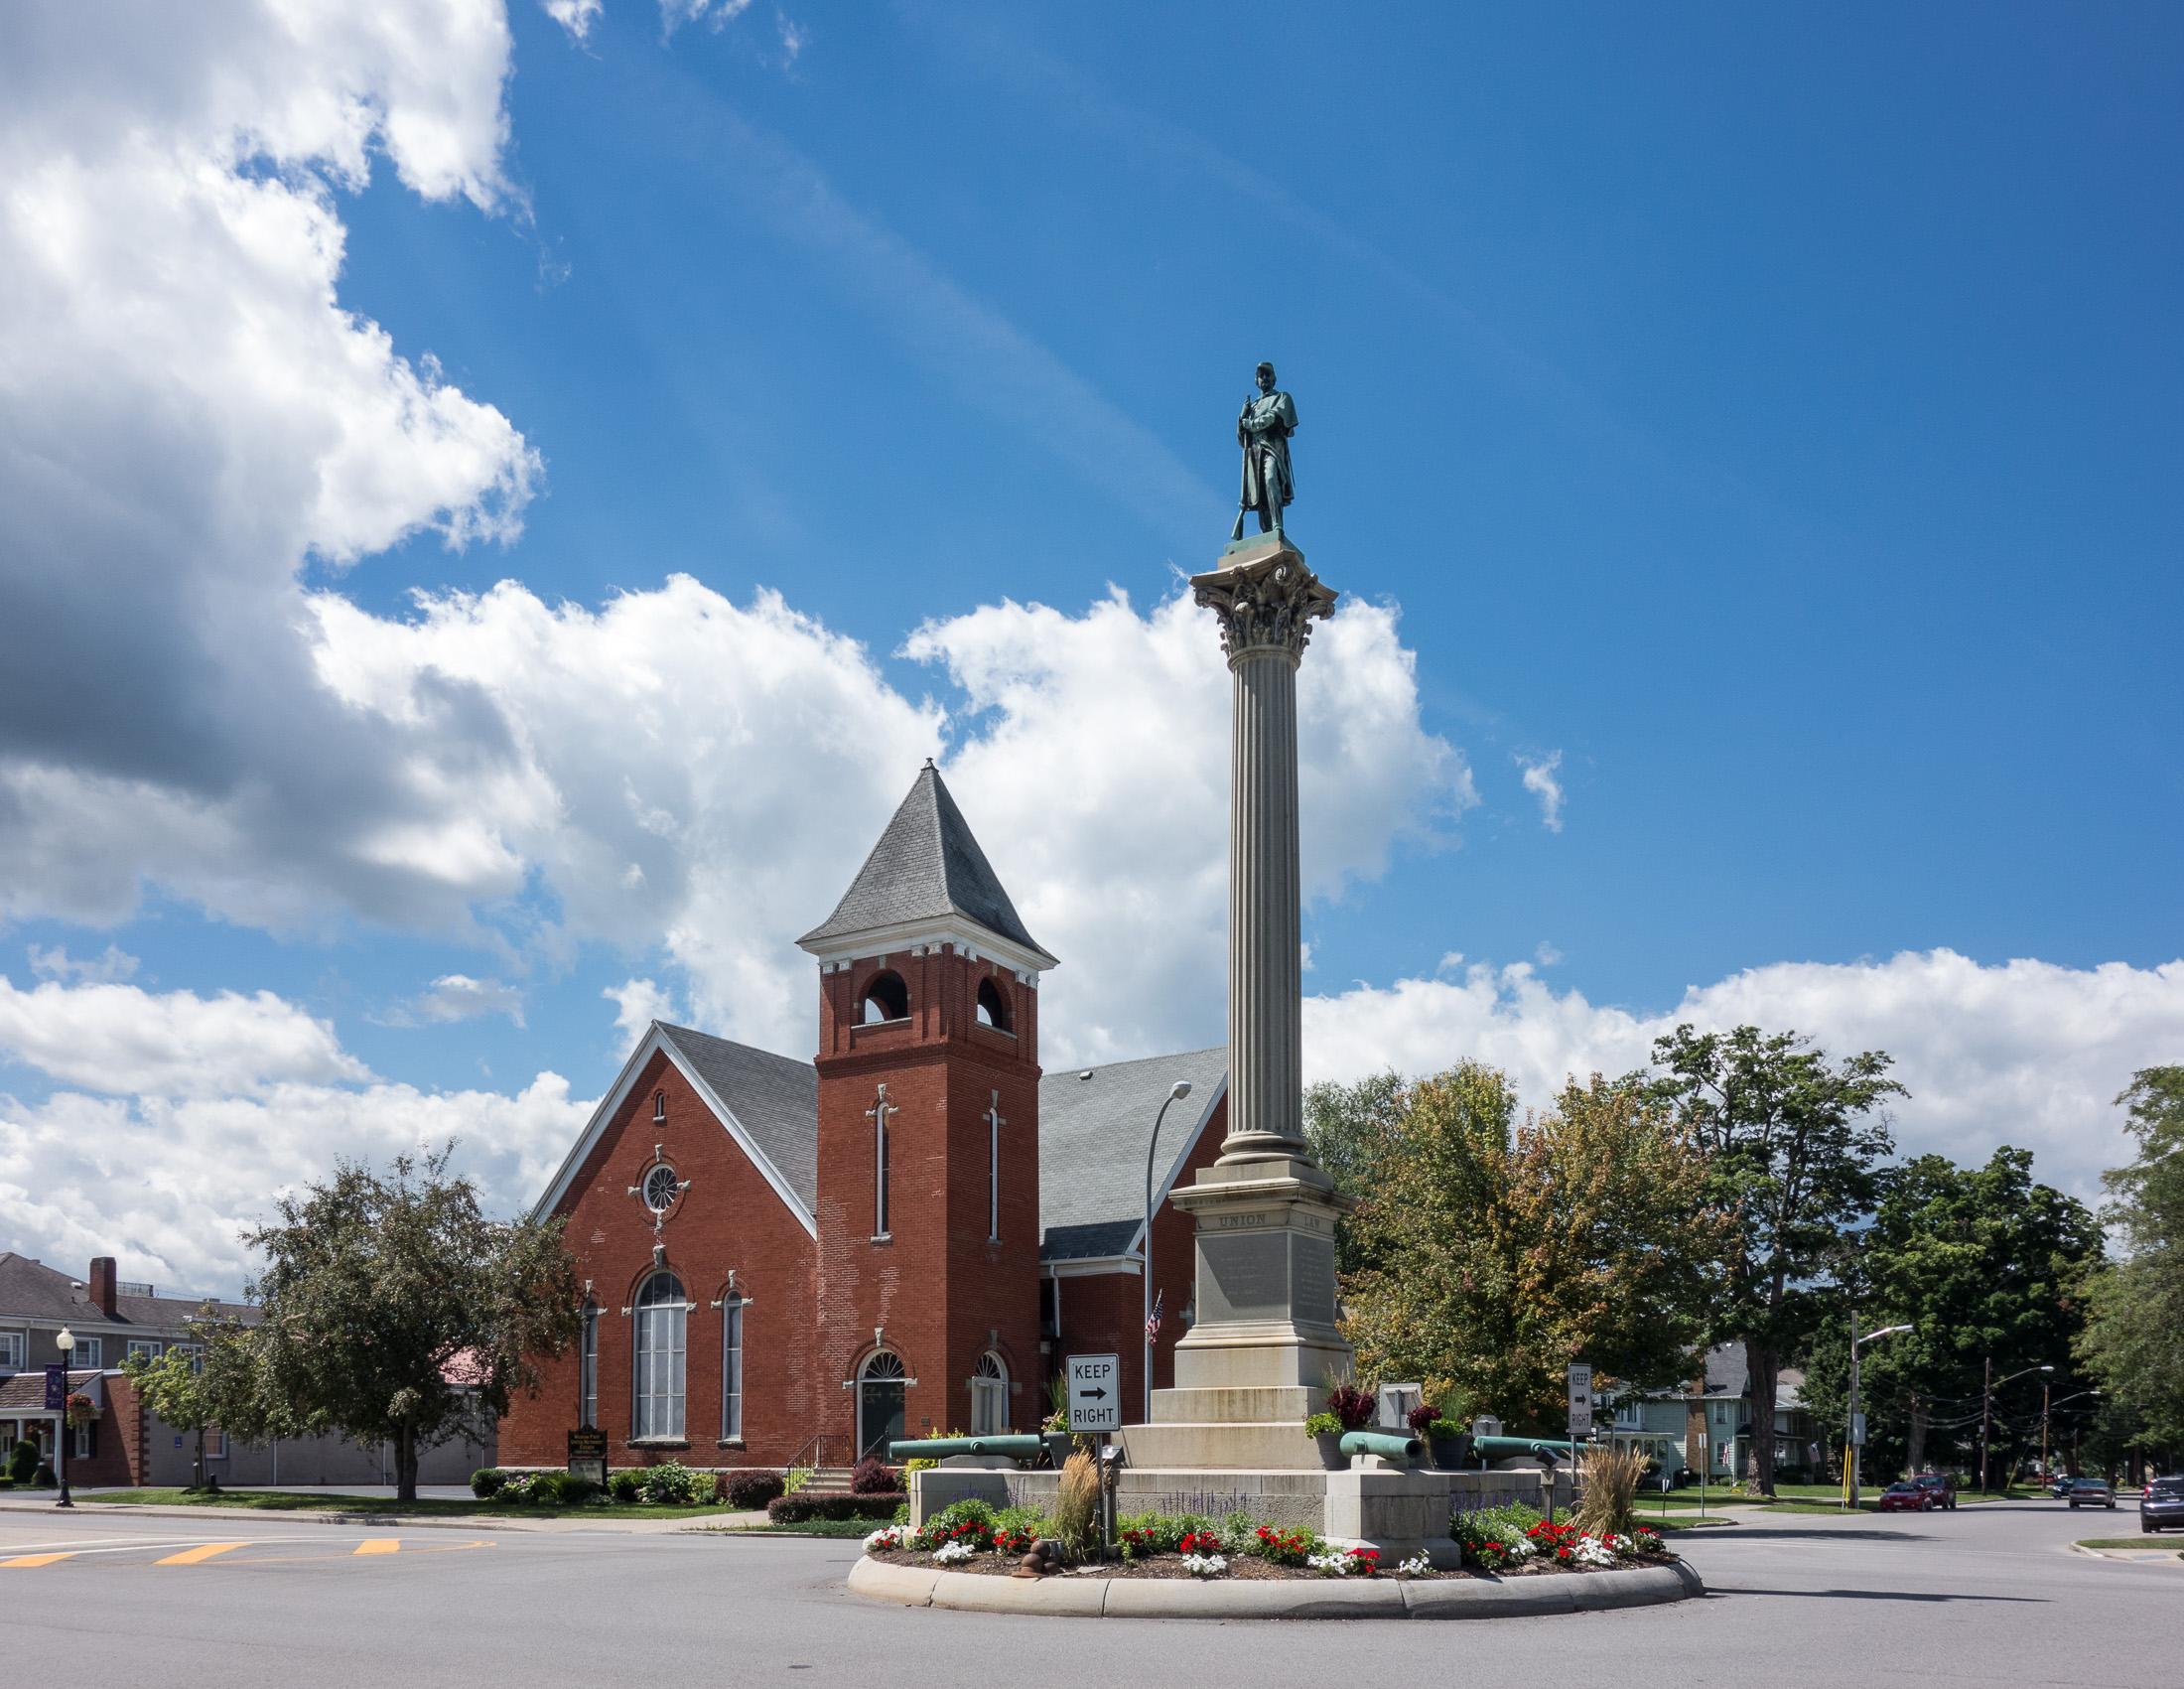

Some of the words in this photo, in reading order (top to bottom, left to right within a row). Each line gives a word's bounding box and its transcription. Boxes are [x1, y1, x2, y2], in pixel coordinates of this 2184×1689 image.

[1219, 1213, 1267, 1227] UNION
[1303, 1216, 1320, 1229] LAW
[1075, 1364, 1111, 1379] KEEP
[1571, 1373, 1588, 1386] KEEP
[1074, 1408, 1114, 1423] RIGHT
[1571, 1413, 1589, 1427] RIGHT
